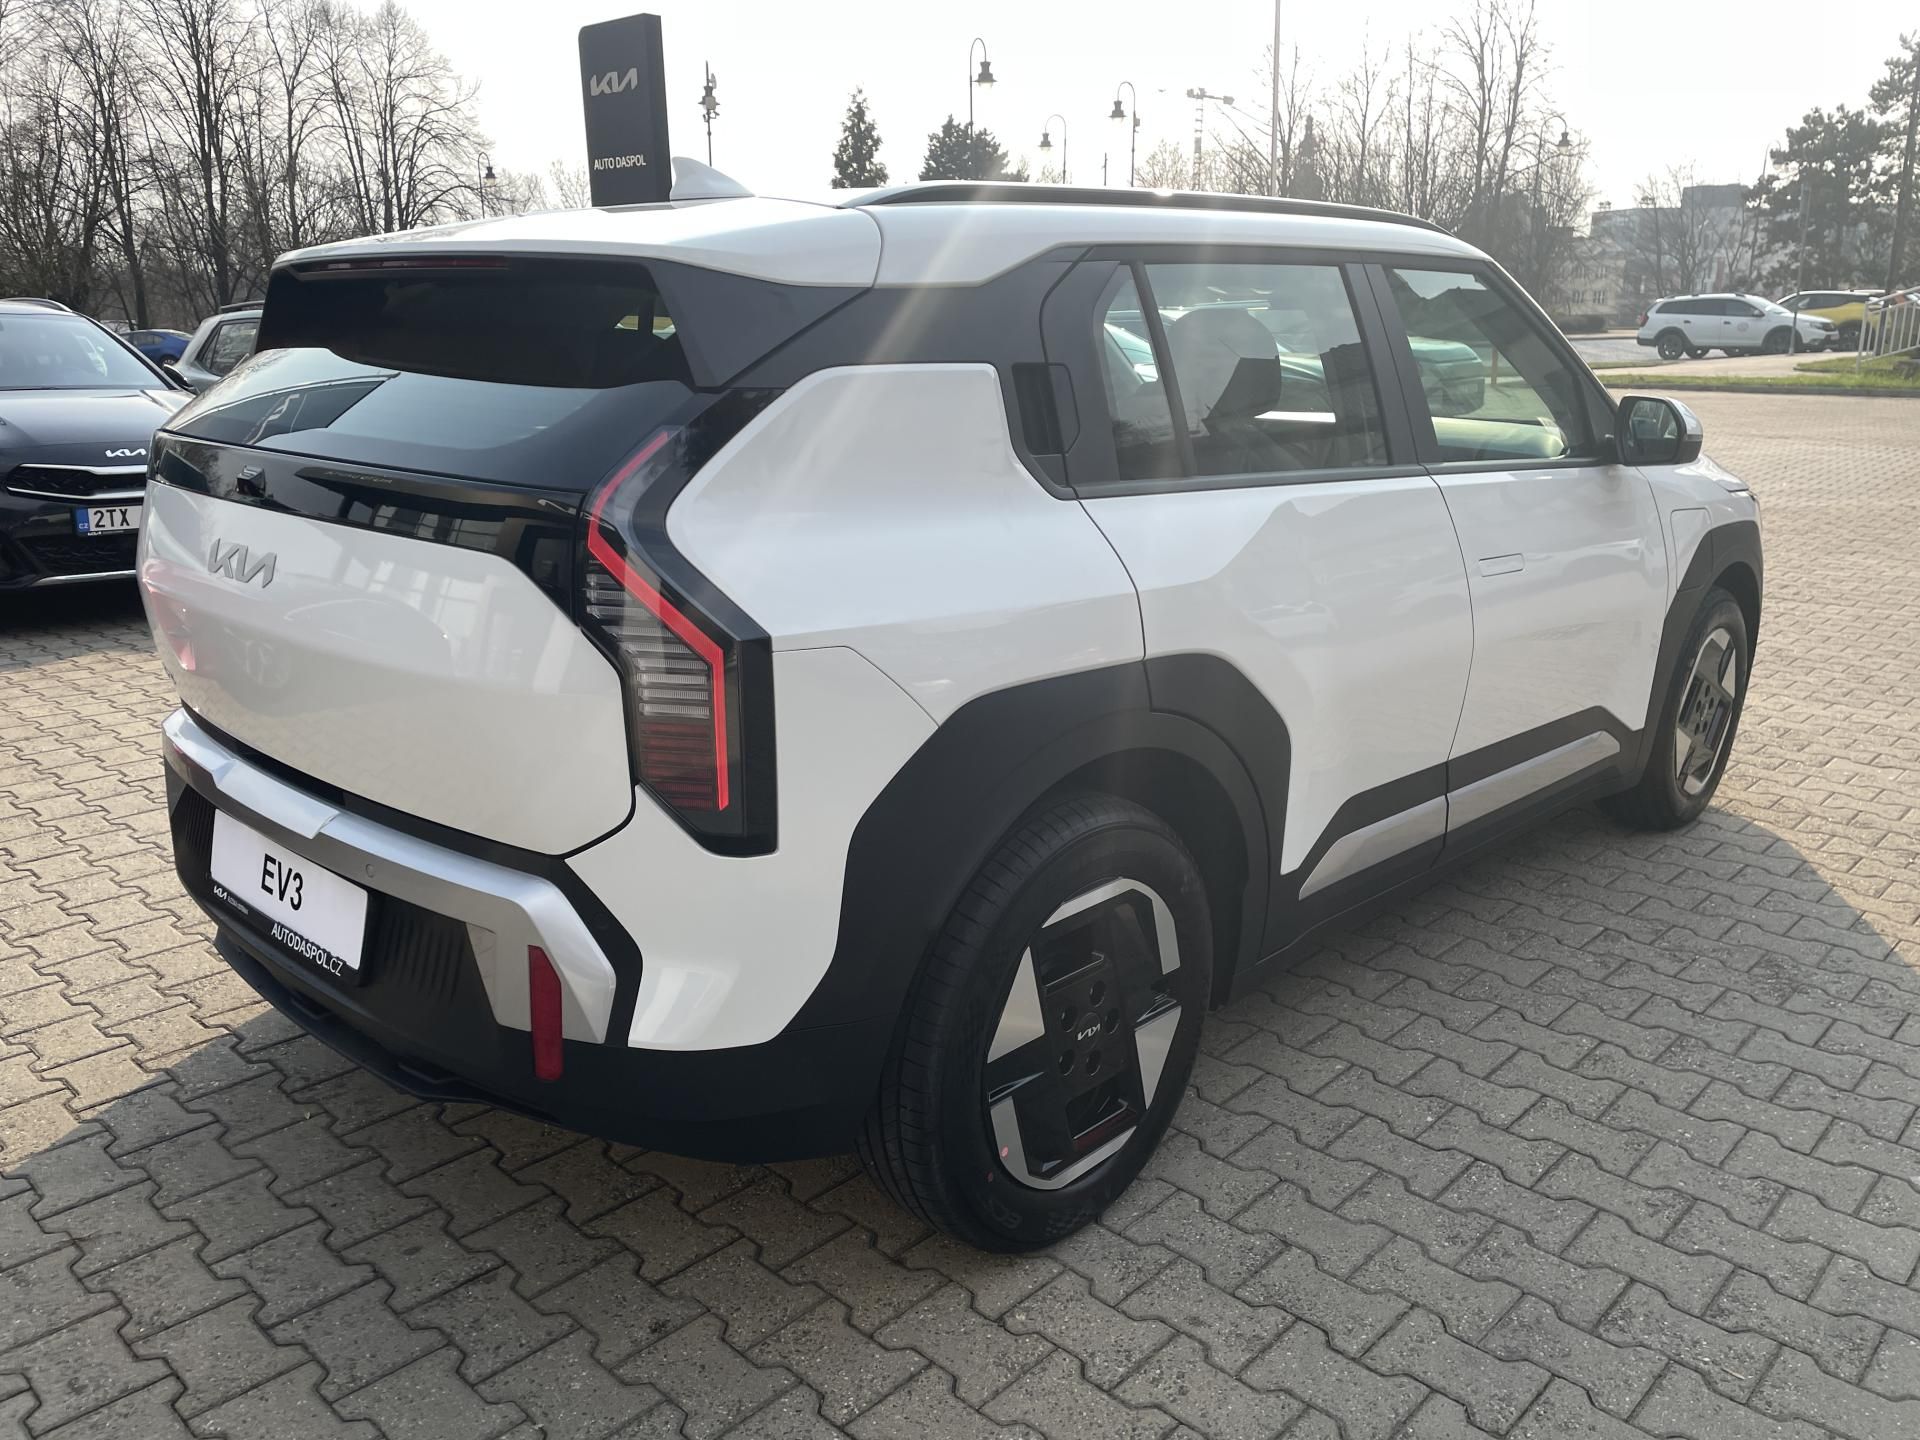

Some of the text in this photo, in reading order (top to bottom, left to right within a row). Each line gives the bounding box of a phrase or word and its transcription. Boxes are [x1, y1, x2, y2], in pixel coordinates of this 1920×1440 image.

[590, 67, 638, 96] KIA
[594, 154, 647, 171] AUTO DASPOL
[105, 448, 147, 458] KIA
[93, 508, 130, 529] 2TX
[207, 538, 278, 589] KIA
[213, 885, 228, 900] KIA
[261, 853, 304, 911] EV3
[271, 923, 344, 976] AUTODASPOL.CZ
